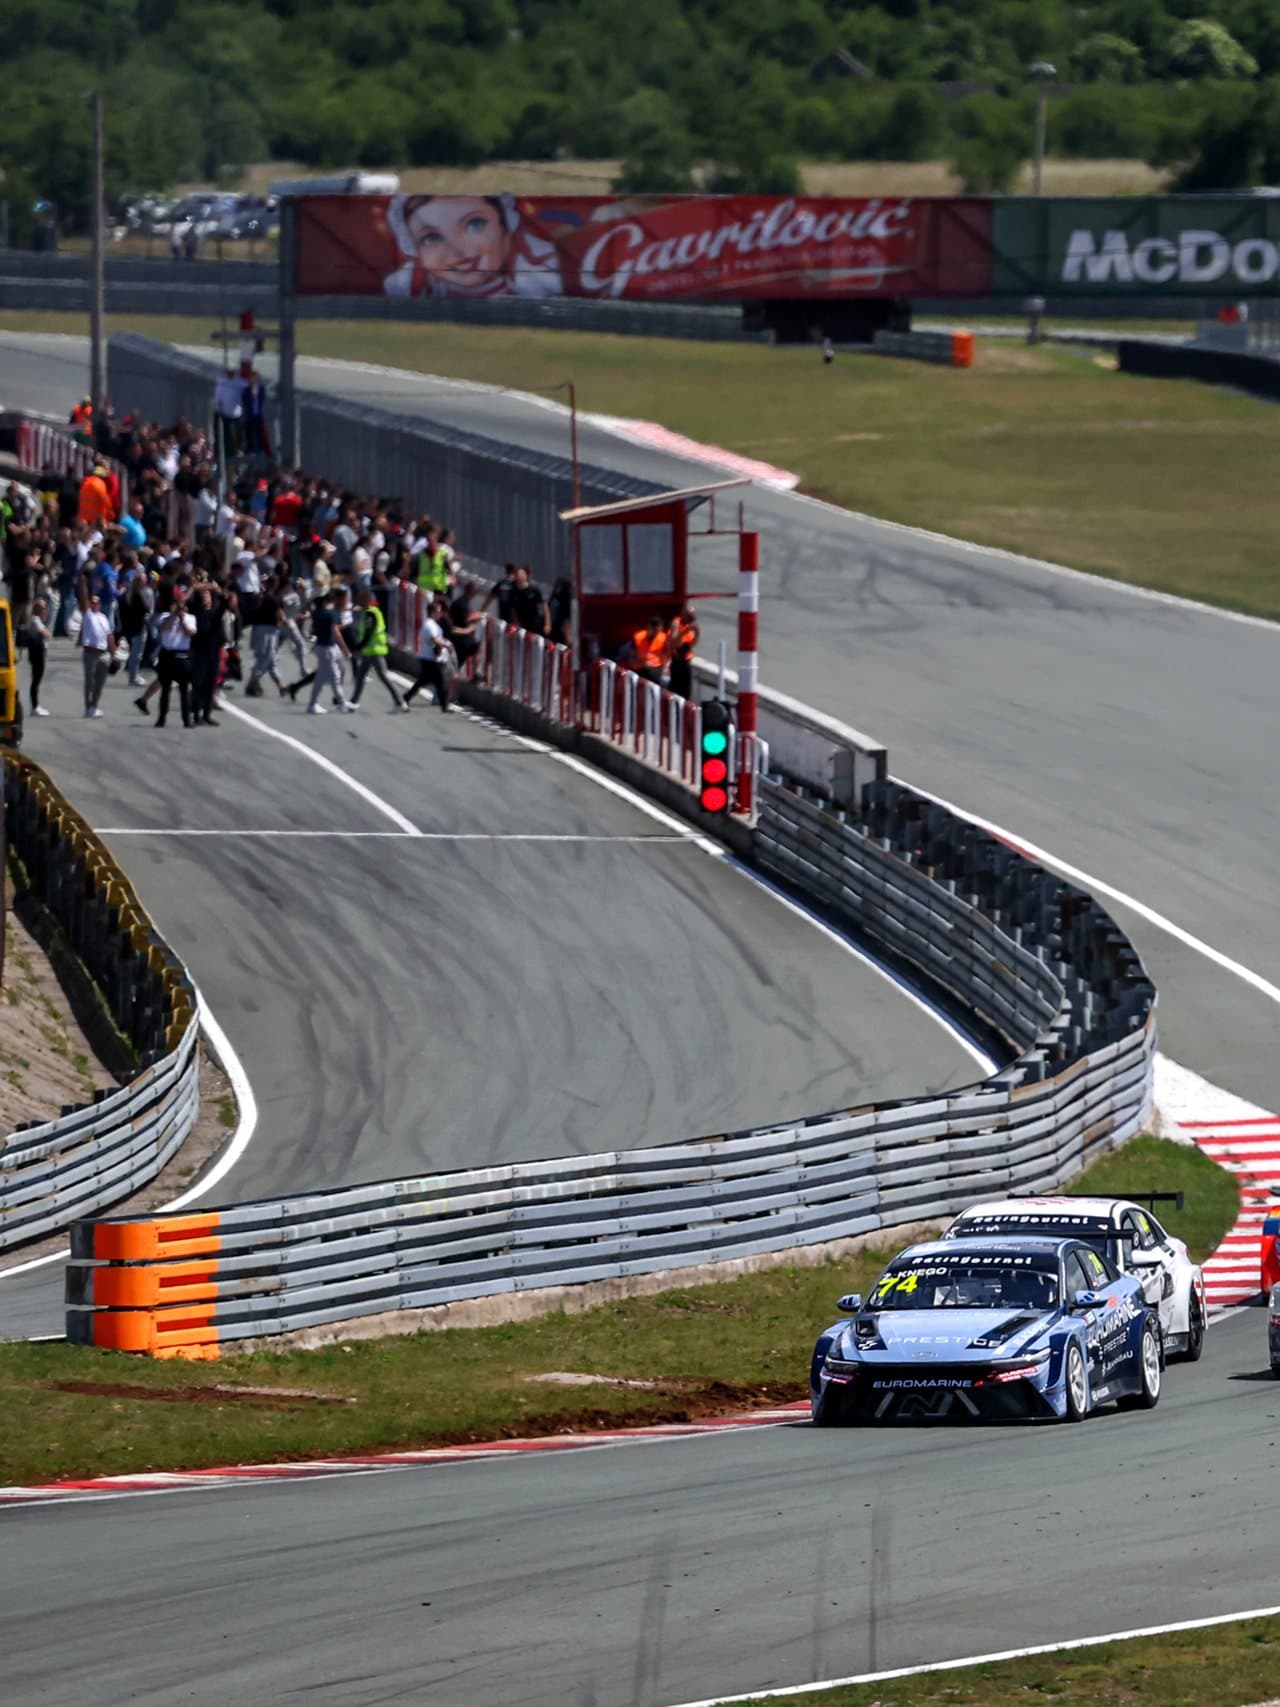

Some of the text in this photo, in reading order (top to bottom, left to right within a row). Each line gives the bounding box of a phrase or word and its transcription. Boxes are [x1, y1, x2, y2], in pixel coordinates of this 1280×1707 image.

[898, 1266, 947, 1278] KNEGO
[878, 1275, 918, 1297] 74
[888, 1335, 1003, 1347] PRESTIGE
[873, 1379, 972, 1389] EUROMARINE
